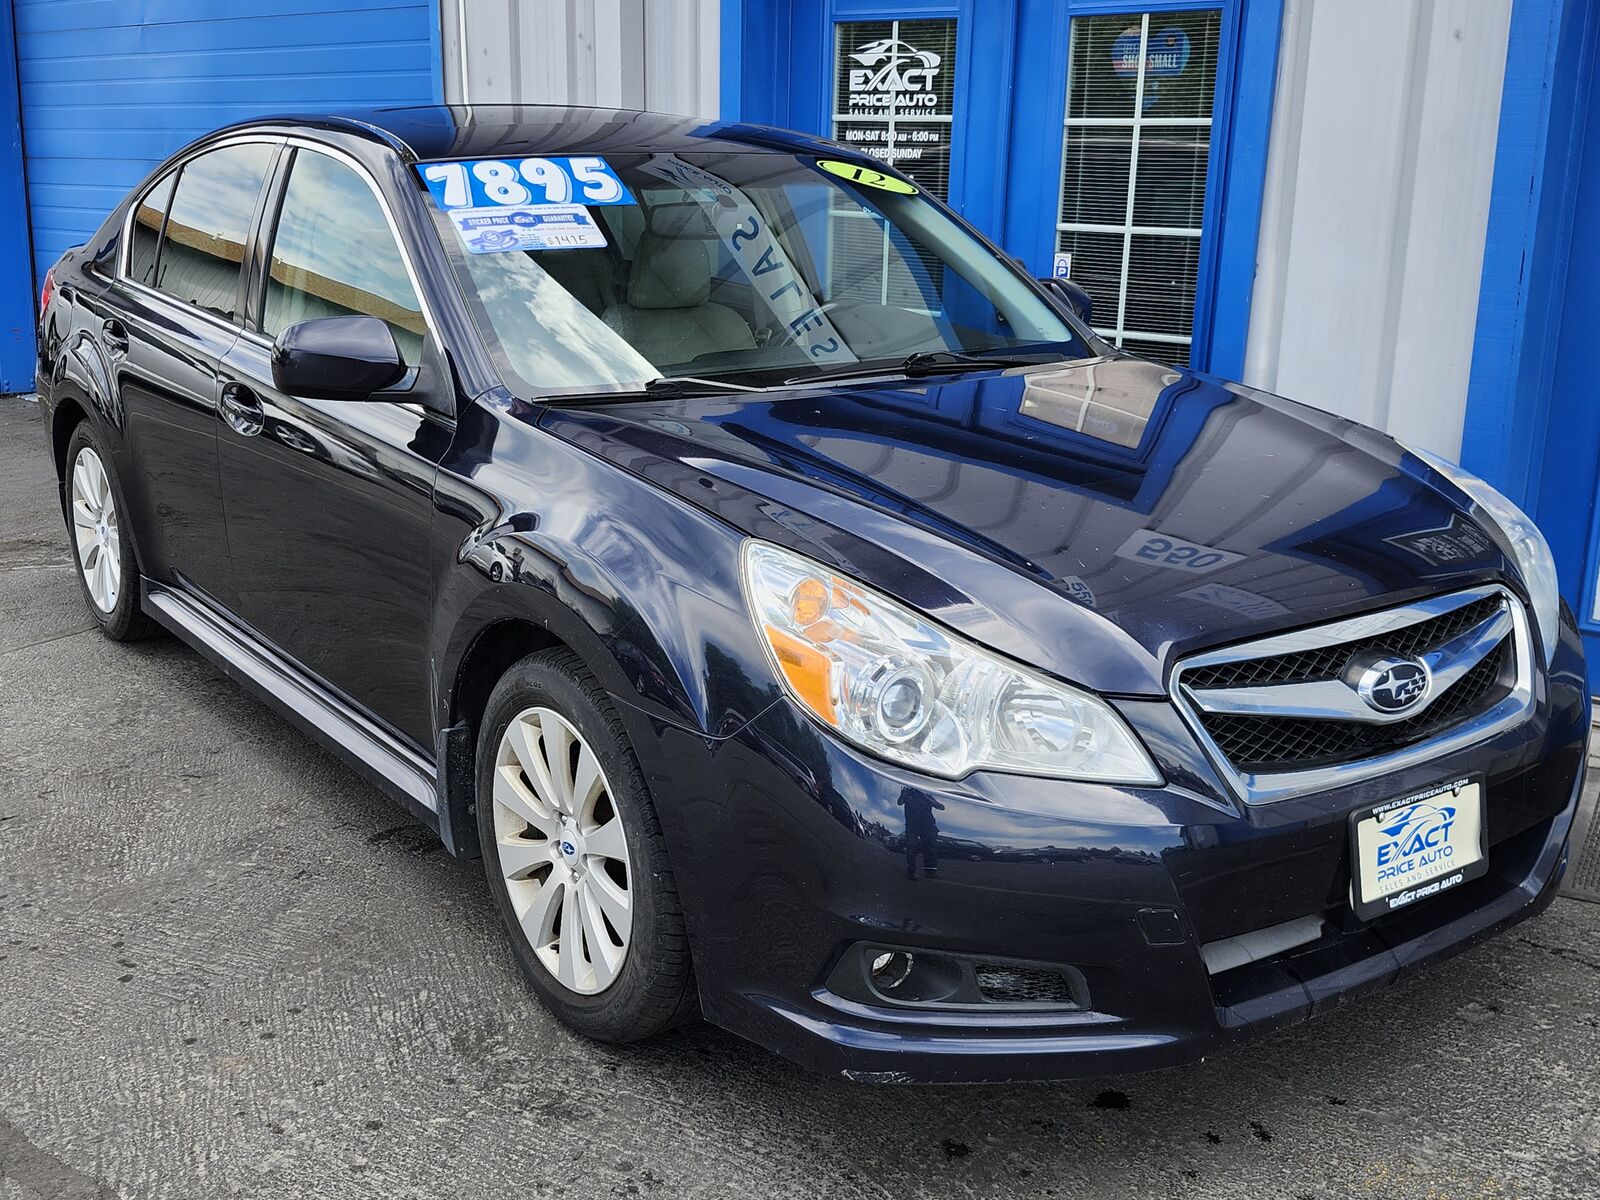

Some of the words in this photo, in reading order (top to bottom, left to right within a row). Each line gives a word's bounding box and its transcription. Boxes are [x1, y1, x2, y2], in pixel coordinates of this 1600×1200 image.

[1149, 54, 1178, 68] SMALL
[849, 68, 940, 91] EXACT
[849, 94, 891, 106] PRICE
[895, 94, 938, 106] AUTO
[849, 108, 874, 117] SALES
[900, 108, 936, 117] SERVICE
[845, 130, 880, 141] MON-SAT
[898, 133, 907, 141] AM
[912, 131, 929, 142] 6:00
[929, 133, 939, 142] PM
[891, 148, 923, 159] SUNDAY
[425, 157, 623, 208] 7895
[853, 168, 886, 187] 12
[468, 217, 492, 225] STICKER
[492, 216, 510, 224] PRICE
[542, 214, 575, 222] GUARANTEE
[1372, 778, 1469, 815] WWW.EXACTPRICEAUTO.COM
[1377, 820, 1455, 868] EXACT
[1377, 858, 1416, 882] PRICE
[1418, 845, 1454, 867] AUTO
[1379, 880, 1404, 895] SALES
[1407, 871, 1422, 883] AND
[1425, 859, 1457, 877] SERVICE
[1389, 890, 1417, 909] EXACT
[1415, 882, 1440, 899] PRICE
[1440, 873, 1464, 890] AUTO
